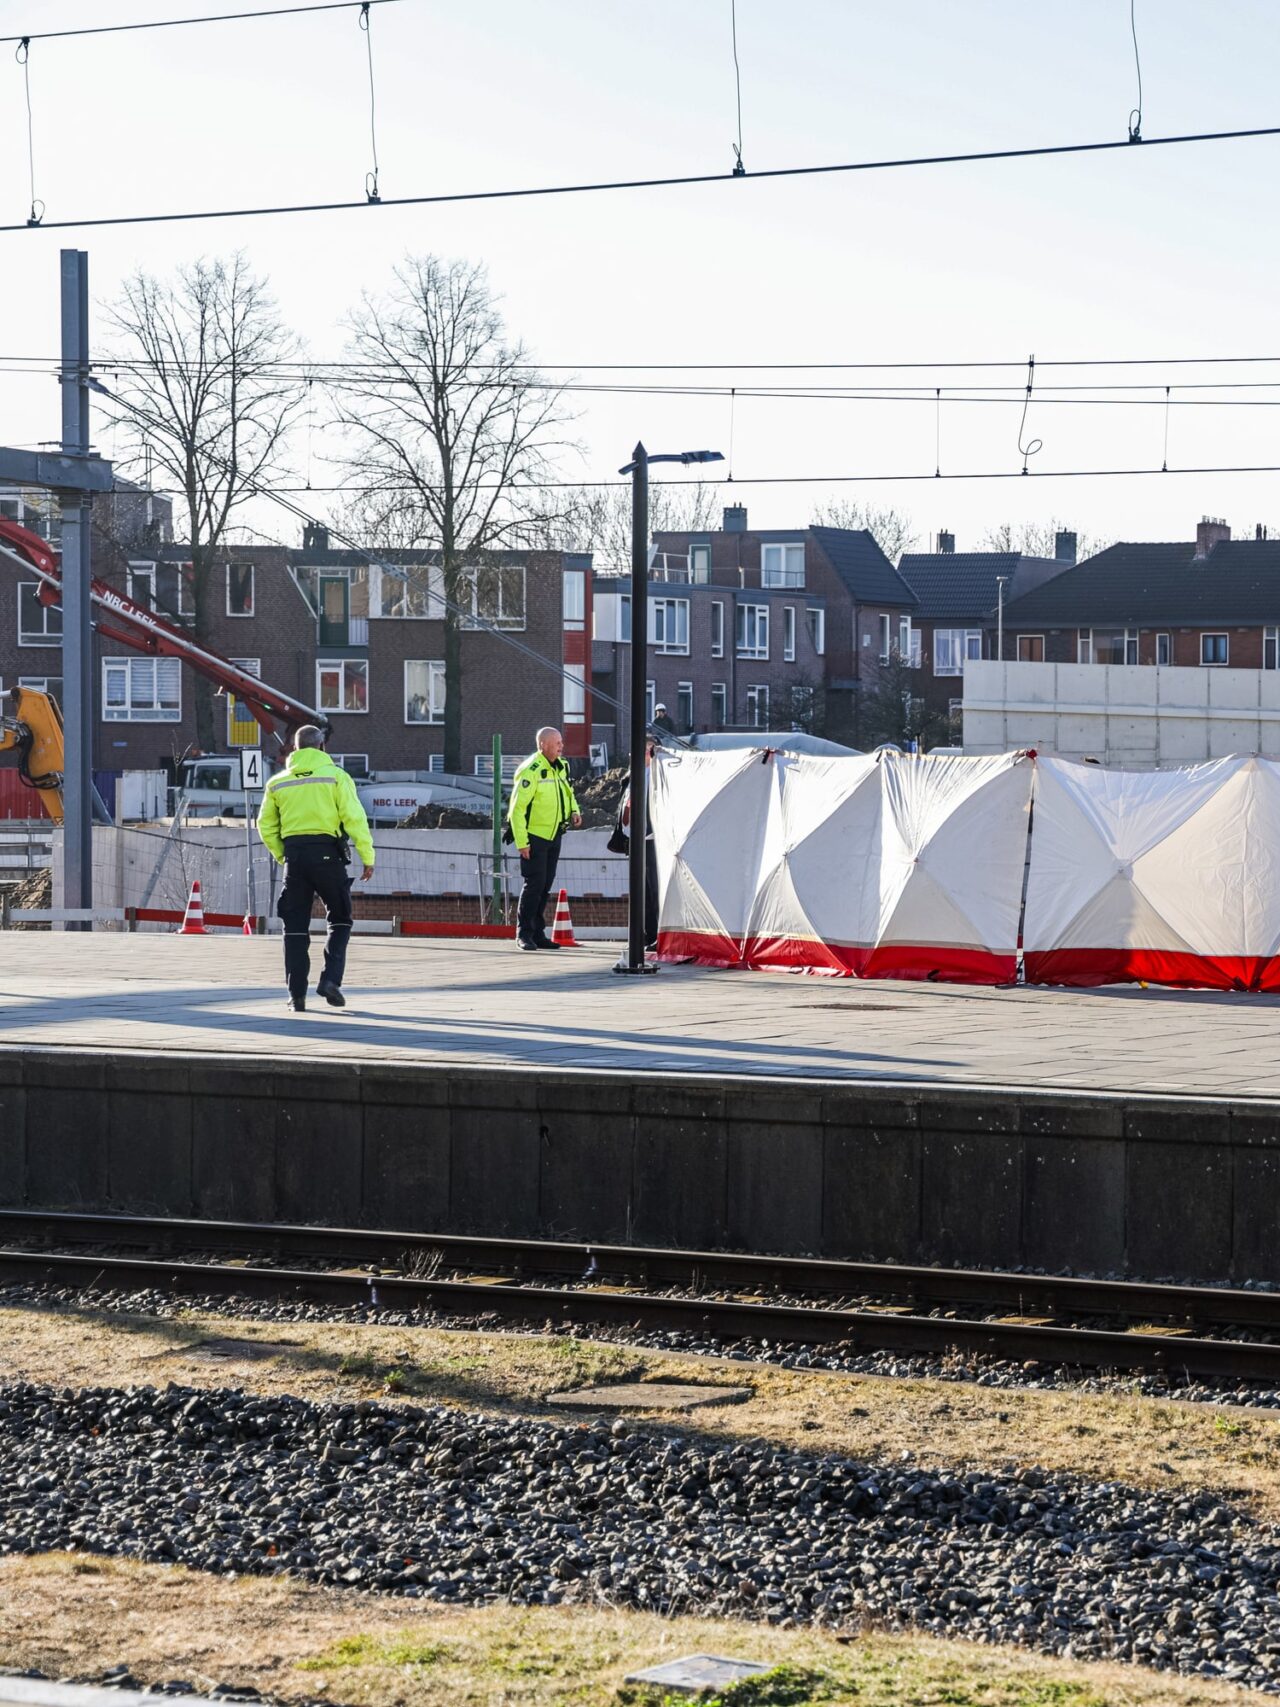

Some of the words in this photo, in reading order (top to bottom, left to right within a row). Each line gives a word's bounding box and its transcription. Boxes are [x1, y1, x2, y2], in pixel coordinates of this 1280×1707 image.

[103, 590, 129, 612] NBC
[247, 754, 258, 784] 4
[373, 798, 392, 807] NBC
[394, 798, 417, 807] LEEK
